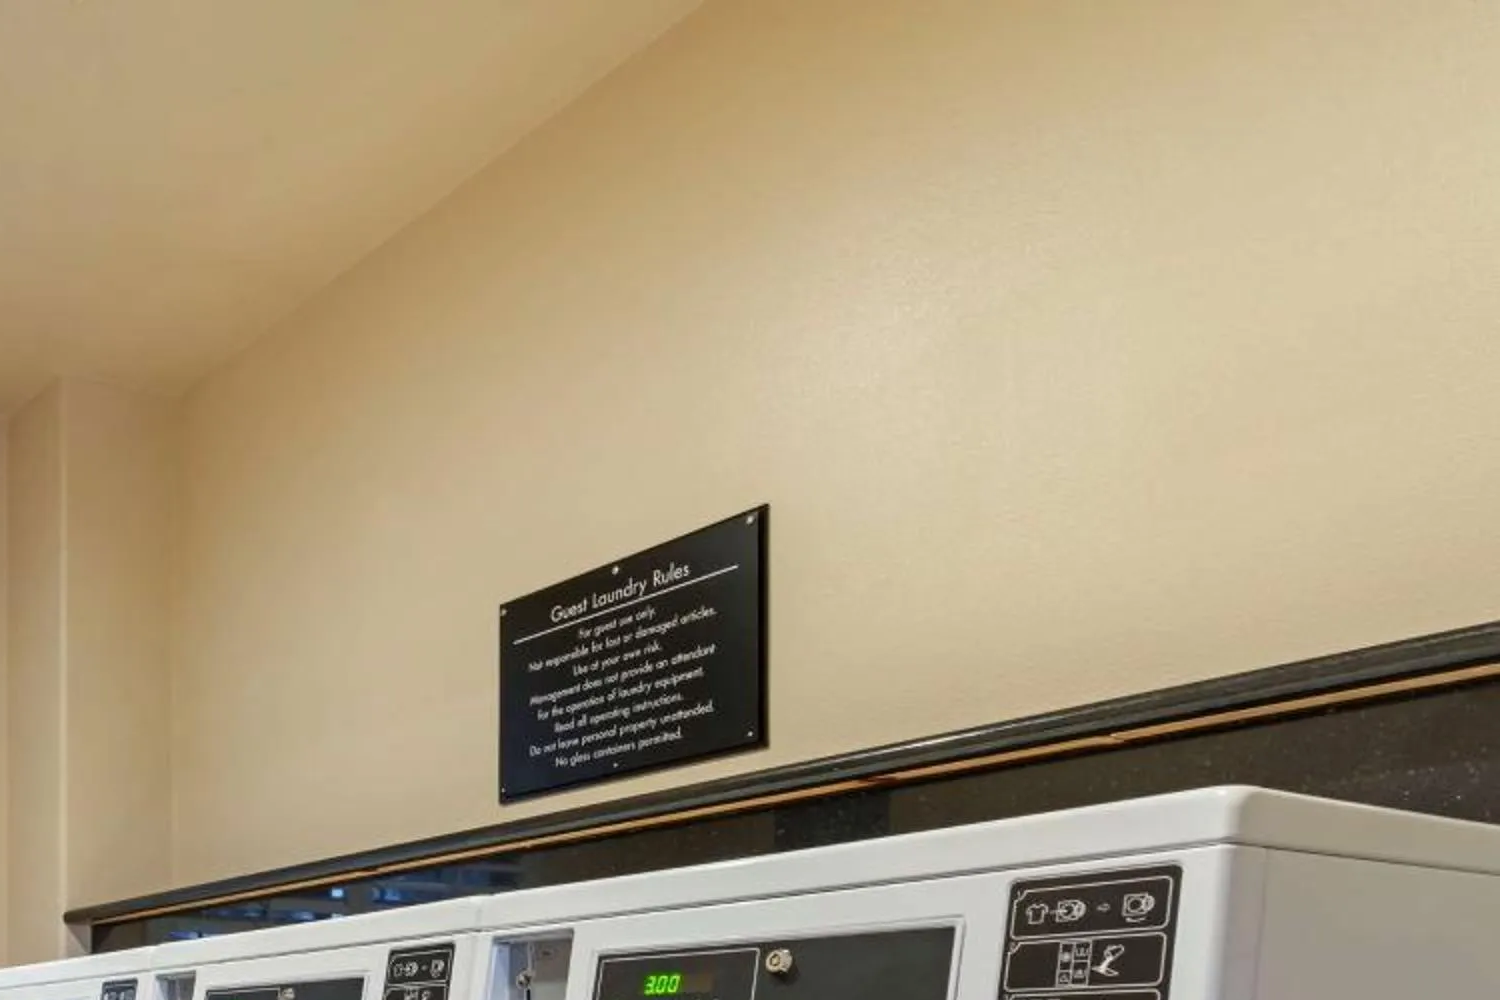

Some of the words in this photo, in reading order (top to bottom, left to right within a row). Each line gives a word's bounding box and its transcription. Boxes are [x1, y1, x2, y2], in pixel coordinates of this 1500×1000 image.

[551, 599, 587, 622] Guest
[592, 576, 647, 609] Laundry
[653, 562, 689, 587] Rules
[594, 617, 617, 637] guest
[619, 615, 633, 627] use
[528, 660, 543, 672] Not
[545, 646, 589, 668] responsible
[605, 635, 621, 648] lost
[623, 632, 633, 642] or
[636, 617, 678, 639] damaged
[573, 662, 588, 676] Use
[601, 655, 620, 670] your
[623, 649, 641, 661] own
[529, 683, 581, 706] Management
[581, 677, 602, 691] does
[604, 672, 619, 684] not
[620, 661, 653, 682] provide
[655, 658, 669, 669] an
[670, 643, 717, 665] attendant
[551, 705, 564, 717] the
[566, 695, 605, 714] operation
[606, 687, 617, 701] of
[618, 681, 652, 699] laundry
[529, 745, 542, 757] Do
[543, 742, 557, 753] not
[558, 737, 579, 750] leave
[581, 725, 617, 745] personal
[619, 717, 657, 736] property
[554, 719, 574, 733] Read
[576, 715, 587, 727] all
[590, 706, 630, 725] operating
[555, 756, 568, 768] No
[570, 752, 591, 767] glass
[592, 741, 636, 760] containers
